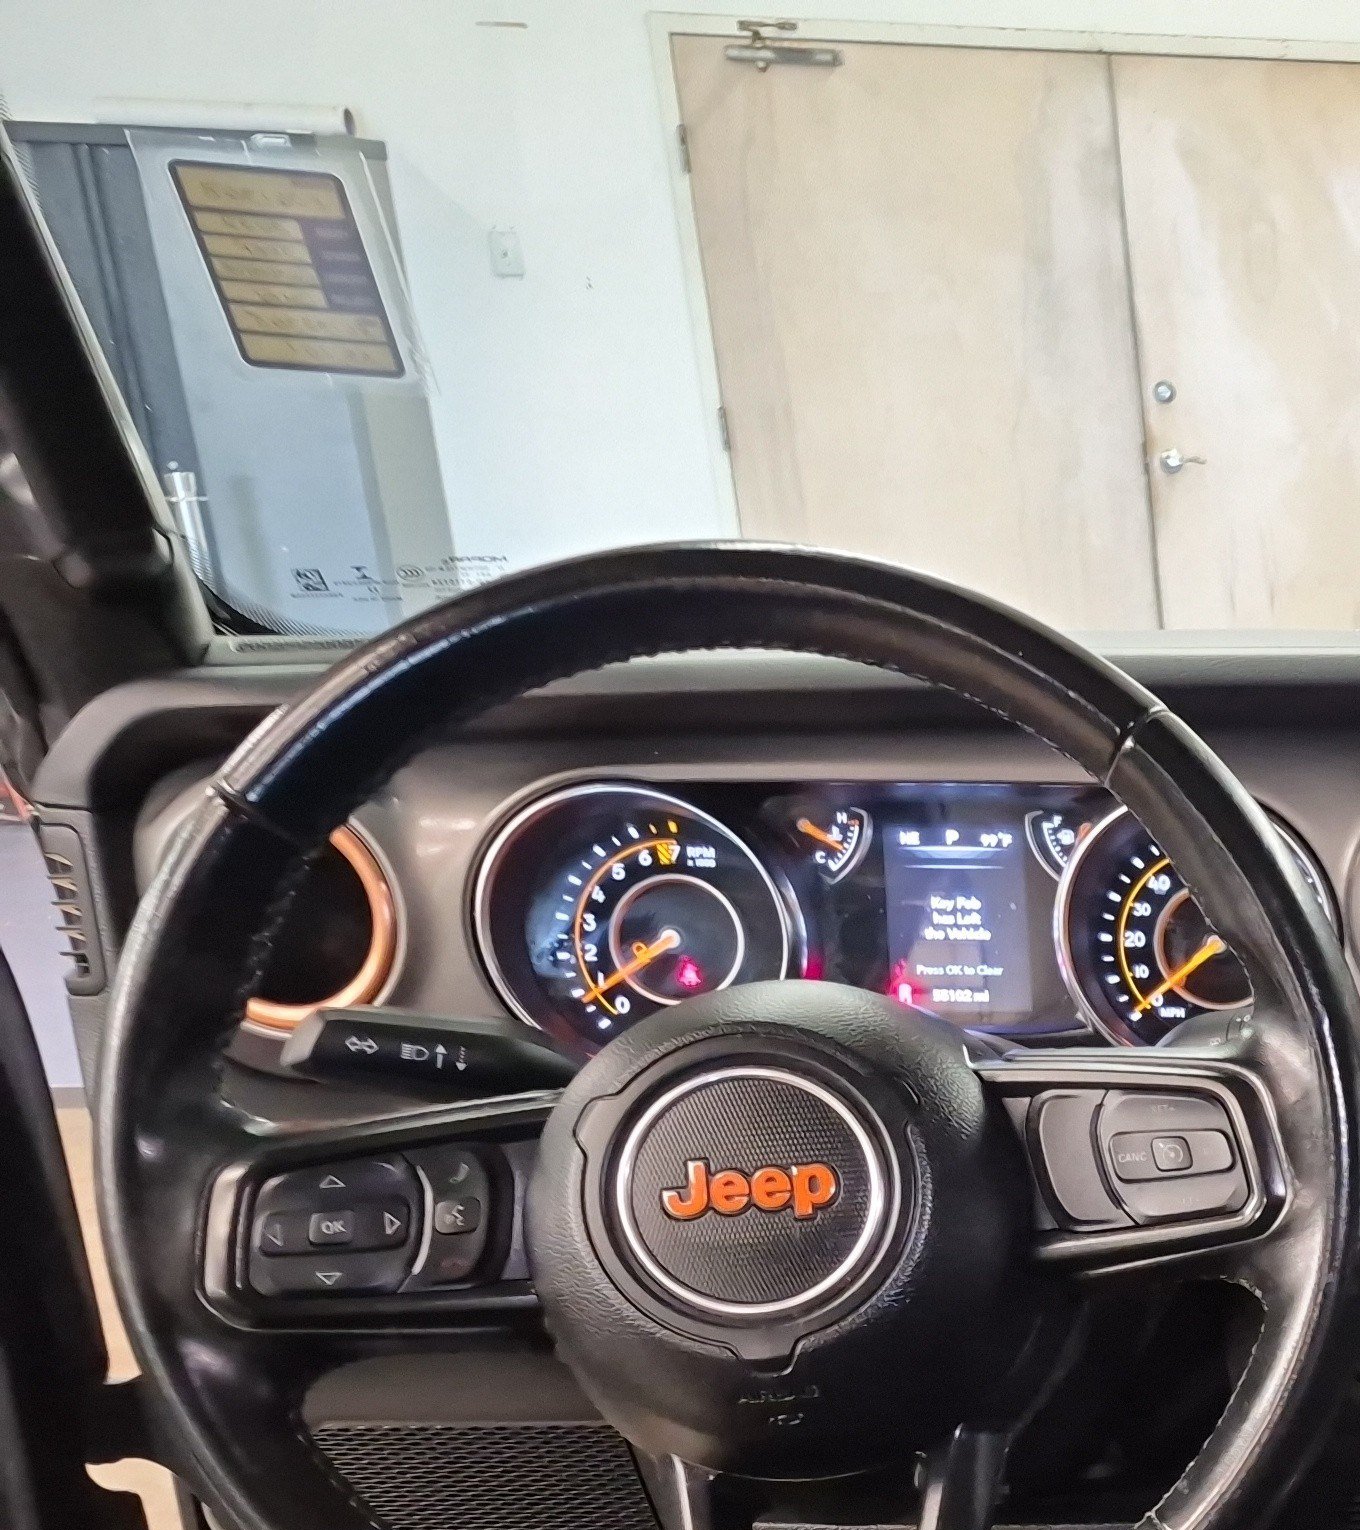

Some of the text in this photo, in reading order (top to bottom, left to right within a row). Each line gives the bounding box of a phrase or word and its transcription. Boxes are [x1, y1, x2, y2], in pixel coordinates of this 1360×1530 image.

[836, 811, 848, 824] H
[945, 829, 959, 845] P
[638, 850, 653, 866] 6
[815, 851, 826, 863] C
[612, 863, 626, 880] 5
[1147, 873, 1171, 892] 40
[592, 886, 606, 903] 4
[931, 895, 955, 911] Key
[1132, 902, 1151, 916] 30
[583, 913, 597, 932] 3
[933, 911, 955, 925] has
[924, 926, 945, 940] the
[1124, 930, 1146, 947] 20
[585, 944, 598, 962] 2
[916, 965, 1003, 976] Press OK to Clear
[1132, 963, 1149, 979] 10
[615, 995, 631, 1014] 0
[1118, 1152, 1148, 1163] CANC
[662, 1158, 838, 1220] Jeep
[321, 1220, 347, 1235] OK
